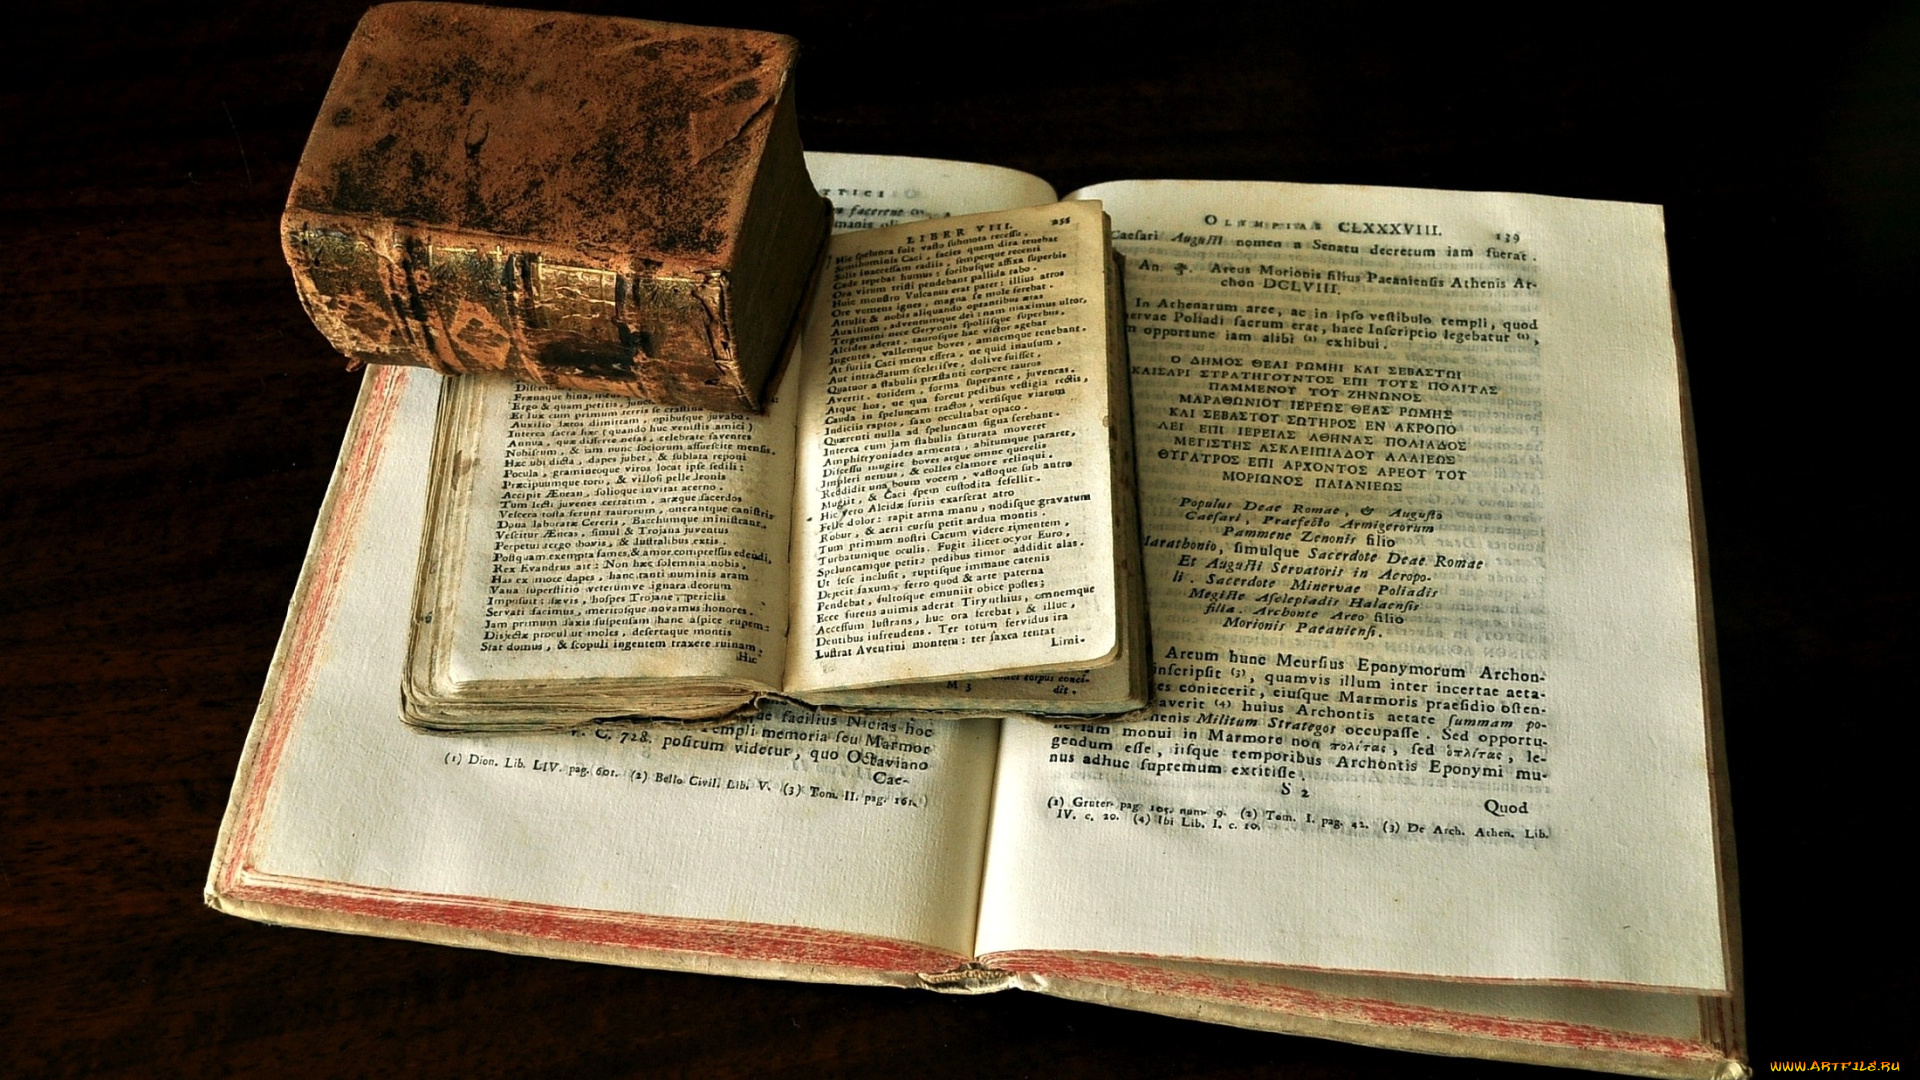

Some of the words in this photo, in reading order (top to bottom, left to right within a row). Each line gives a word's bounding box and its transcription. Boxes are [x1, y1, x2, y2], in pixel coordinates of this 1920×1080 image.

[1496, 233, 1520, 243] 139
[1236, 239, 1282, 248] nomen
[1312, 237, 1359, 254] Senatu
[1370, 245, 1435, 257] decretum
[1447, 246, 1473, 257] iam
[1221, 278, 1254, 287] chon
[1260, 265, 1321, 279] Morionis
[1450, 277, 1505, 288] Athenis
[1513, 278, 1537, 288] Ar-
[1157, 299, 1237, 312] Athenarum
[1503, 319, 1538, 332] quod
[1144, 325, 1215, 339] opportune
[1226, 330, 1251, 341] iam
[1263, 333, 1294, 344] alibi
[1173, 312, 1223, 325] Poliadi
[1444, 330, 1510, 343] legebatur
[1039, 494, 1090, 508] gravatum
[967, 516, 996, 525] ardua
[1340, 519, 1434, 533] Armigerorum
[1223, 526, 1292, 540] Pammene
[850, 538, 892, 551] primum
[1013, 542, 1052, 553] addidit
[1014, 555, 1050, 565] catenis
[1308, 547, 1377, 563] Sacerdote
[1387, 553, 1426, 566] Deae
[1434, 555, 1483, 569] Romae
[1004, 568, 1044, 581] paterna
[1353, 568, 1368, 578] in
[1206, 574, 1275, 588] Sacerdote
[1290, 579, 1360, 594] Minervae
[1378, 585, 1438, 597] Poliadis
[1166, 647, 1218, 661] Areum
[1229, 650, 1266, 665] hunc
[1357, 659, 1465, 678] Eponymorum
[1480, 666, 1546, 683] Archon-
[1340, 676, 1380, 689] illum
[1391, 679, 1428, 692] inter
[1437, 680, 1499, 696] incertae
[1507, 689, 1546, 699] aeta-
[1340, 691, 1418, 708] Marmoris
[1243, 701, 1283, 714] huius
[1296, 704, 1375, 720] Archontis
[1388, 712, 1436, 724] aetate
[782, 709, 837, 726] facilius
[847, 716, 896, 733] Nicias
[762, 727, 827, 742] memoria
[1122, 726, 1171, 739] monui
[1208, 729, 1283, 745] Marmore
[1292, 738, 1320, 749] non
[1196, 713, 1257, 727] Militum
[1442, 728, 1469, 741] Sed
[1478, 731, 1547, 747] opportu-
[469, 754, 498, 767] Dion.
[504, 758, 525, 768] Lib.
[810, 750, 838, 763] quo
[1083, 754, 1129, 769] adhuc
[1232, 747, 1321, 767] temporibus
[1336, 756, 1417, 772] Archontis
[1429, 760, 1503, 778] Eponymi
[873, 772, 910, 786] Cae-
[1484, 799, 1528, 817] Quod
[1057, 809, 1076, 820] IV.
[1182, 817, 1205, 829] Lib.
[1407, 824, 1424, 833] De
[1433, 826, 1465, 836] Arch.
[1525, 829, 1549, 839] Lib.
